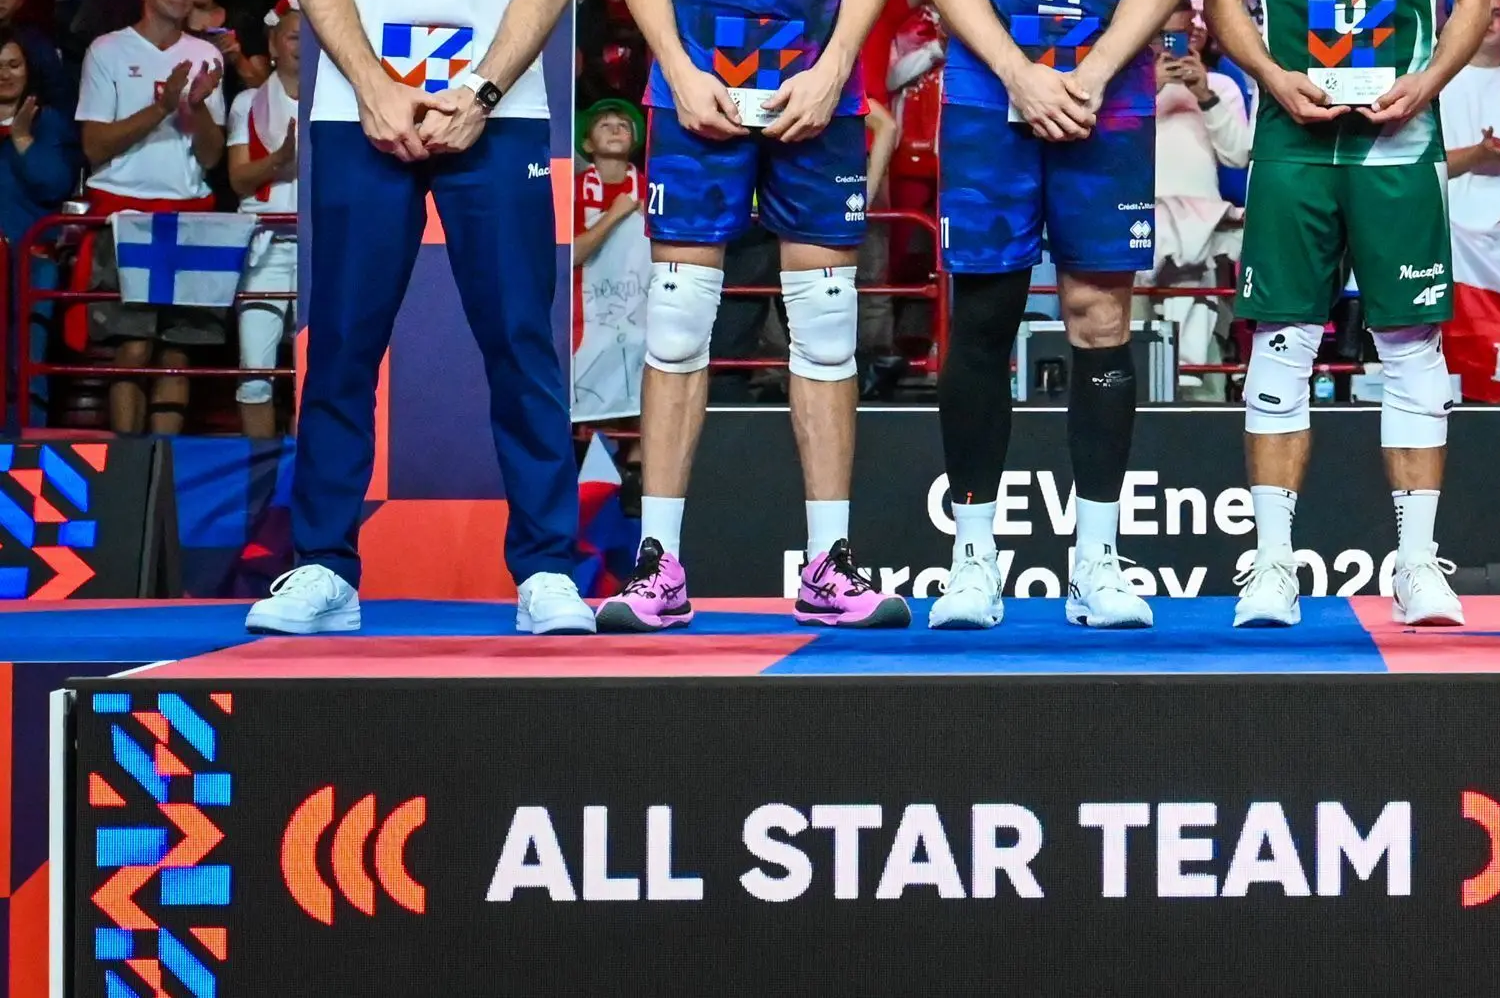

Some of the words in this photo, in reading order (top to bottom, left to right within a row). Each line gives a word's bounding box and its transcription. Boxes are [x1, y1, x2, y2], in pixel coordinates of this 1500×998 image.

[528, 163, 551, 179] Mac
[648, 183, 665, 215] 21
[1413, 284, 1448, 306] 4F
[1119, 470, 1256, 535] Ene
[487, 806, 703, 901] ALL
[740, 804, 1044, 902] STAR
[1079, 802, 1410, 897] TEAM
